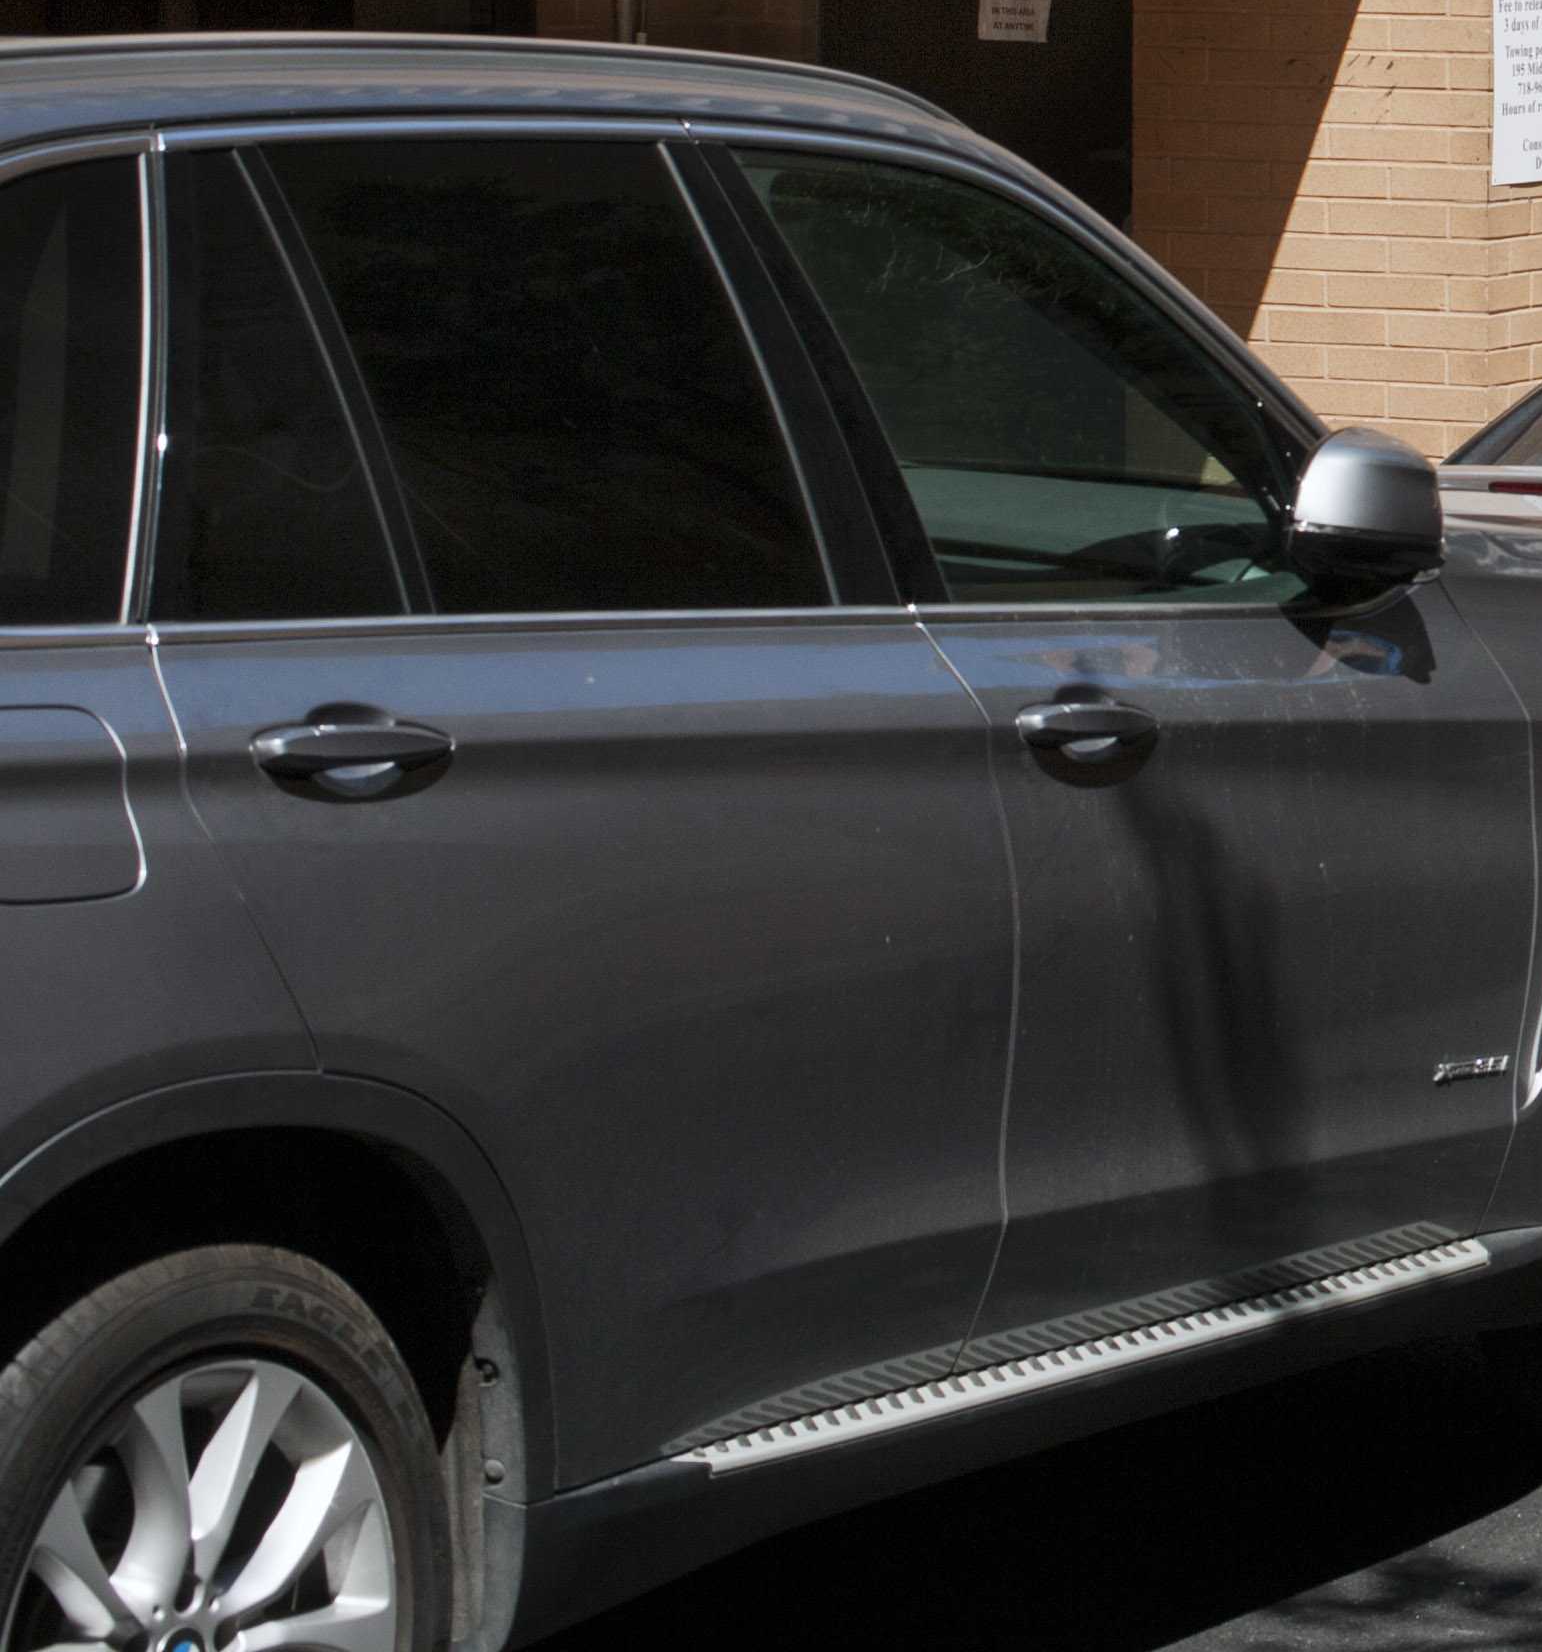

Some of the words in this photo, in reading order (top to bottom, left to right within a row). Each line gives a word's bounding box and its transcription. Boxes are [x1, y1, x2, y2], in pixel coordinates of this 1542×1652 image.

[1499, 0, 1512, 13] Fee
[1511, 17, 1530, 32] days
[1532, 16, 1540, 29] of
[1505, 45, 1532, 60] Towing
[1502, 103, 1525, 116] Hours
[1528, 102, 1536, 114] of
